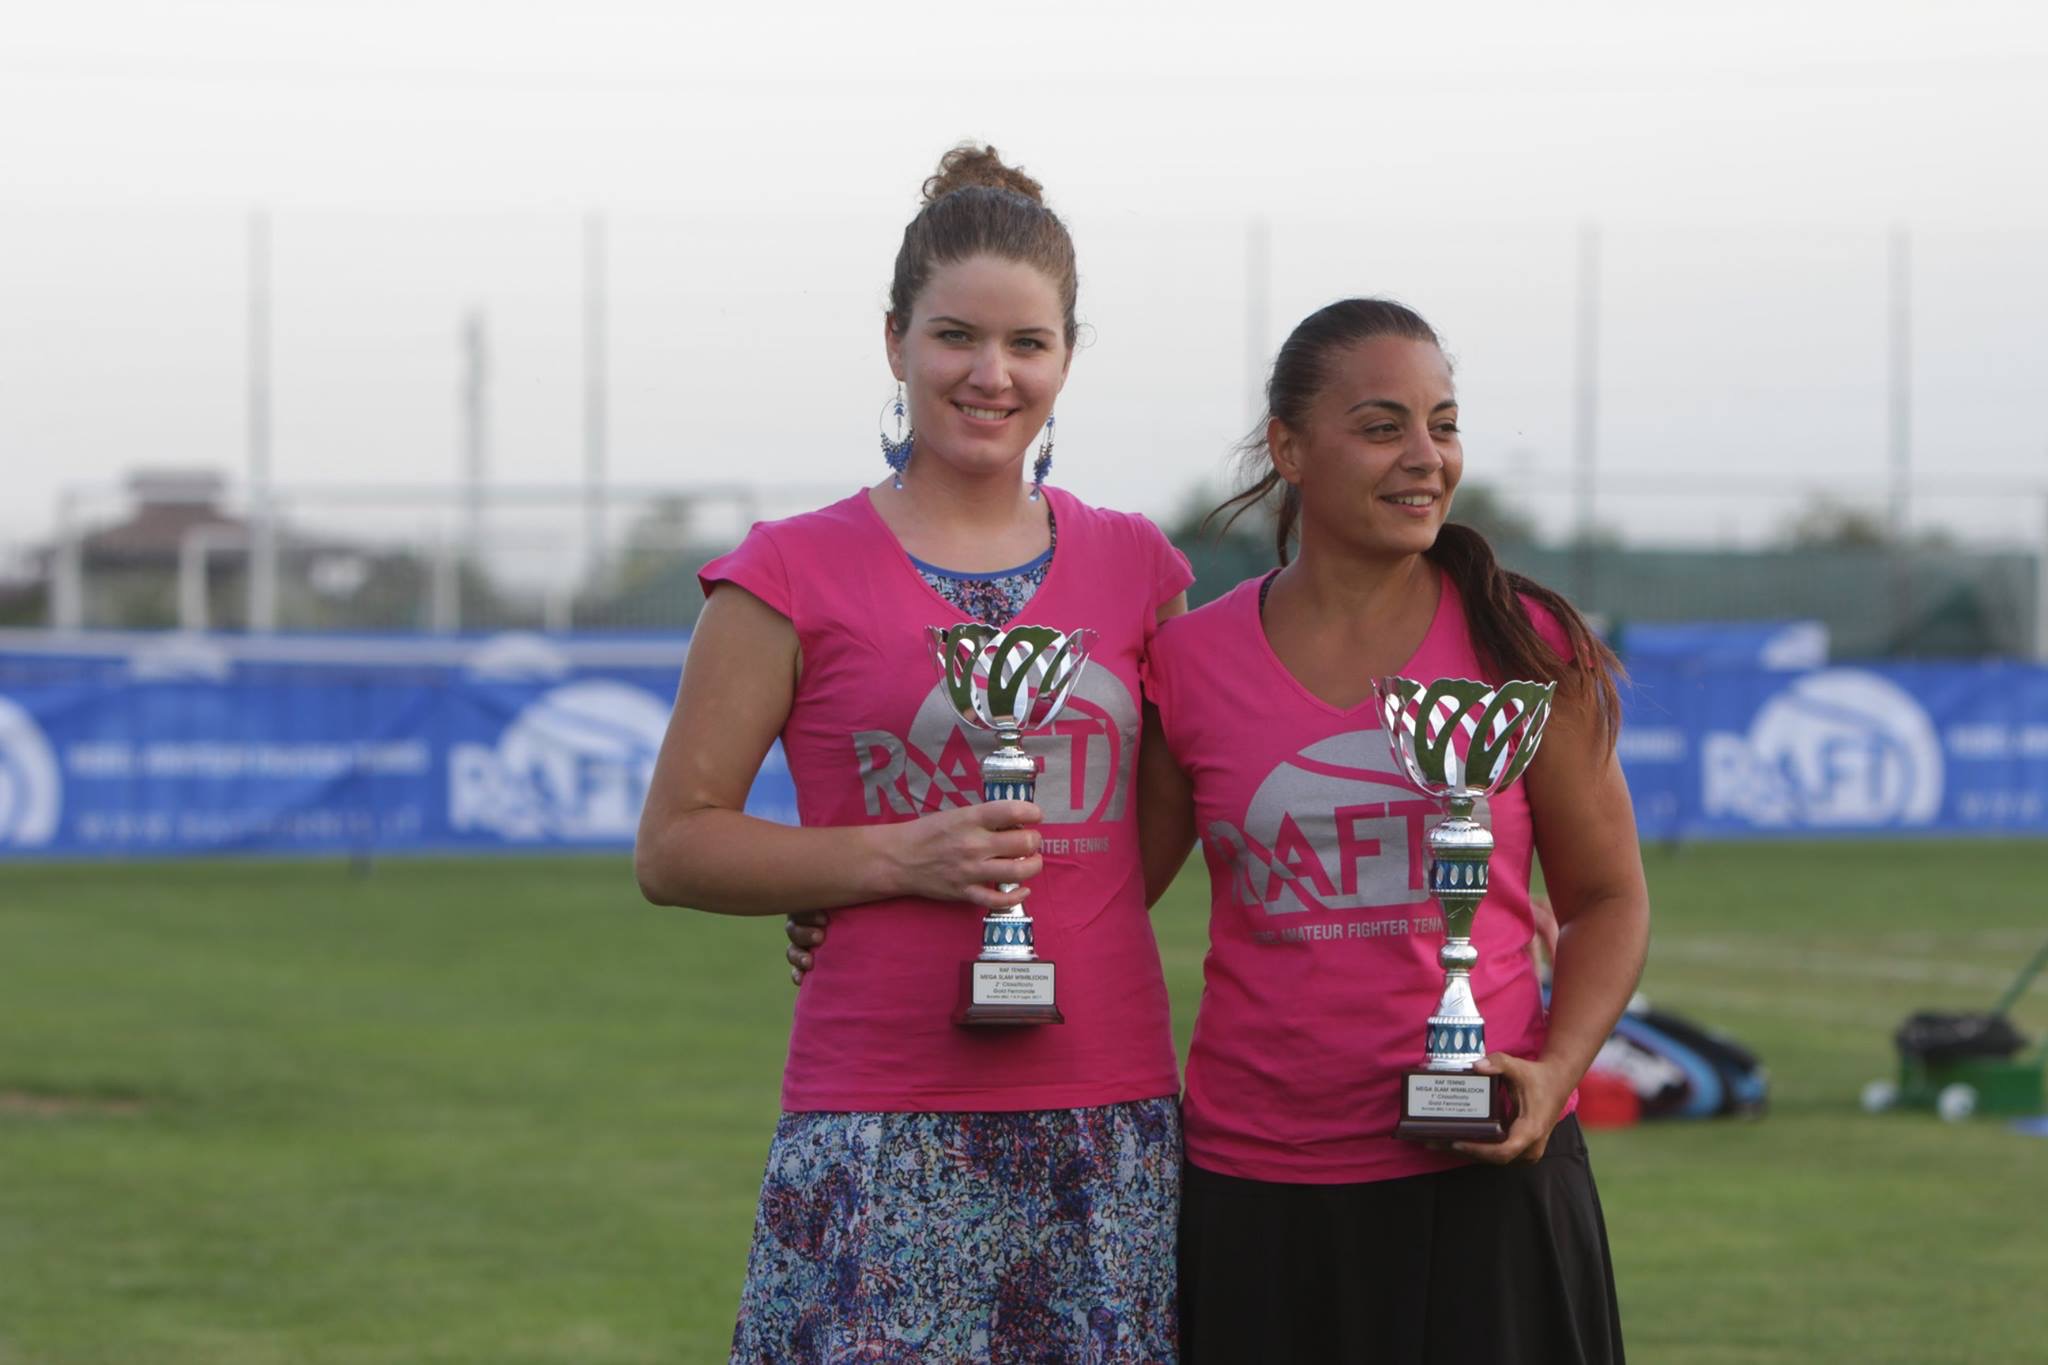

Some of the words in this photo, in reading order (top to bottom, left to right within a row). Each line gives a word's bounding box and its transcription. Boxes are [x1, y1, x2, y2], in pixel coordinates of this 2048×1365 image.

[1208, 799, 1444, 909] RAFT
[1348, 919, 1409, 938] FIGHTER
[1413, 916, 1445, 934] TENN
